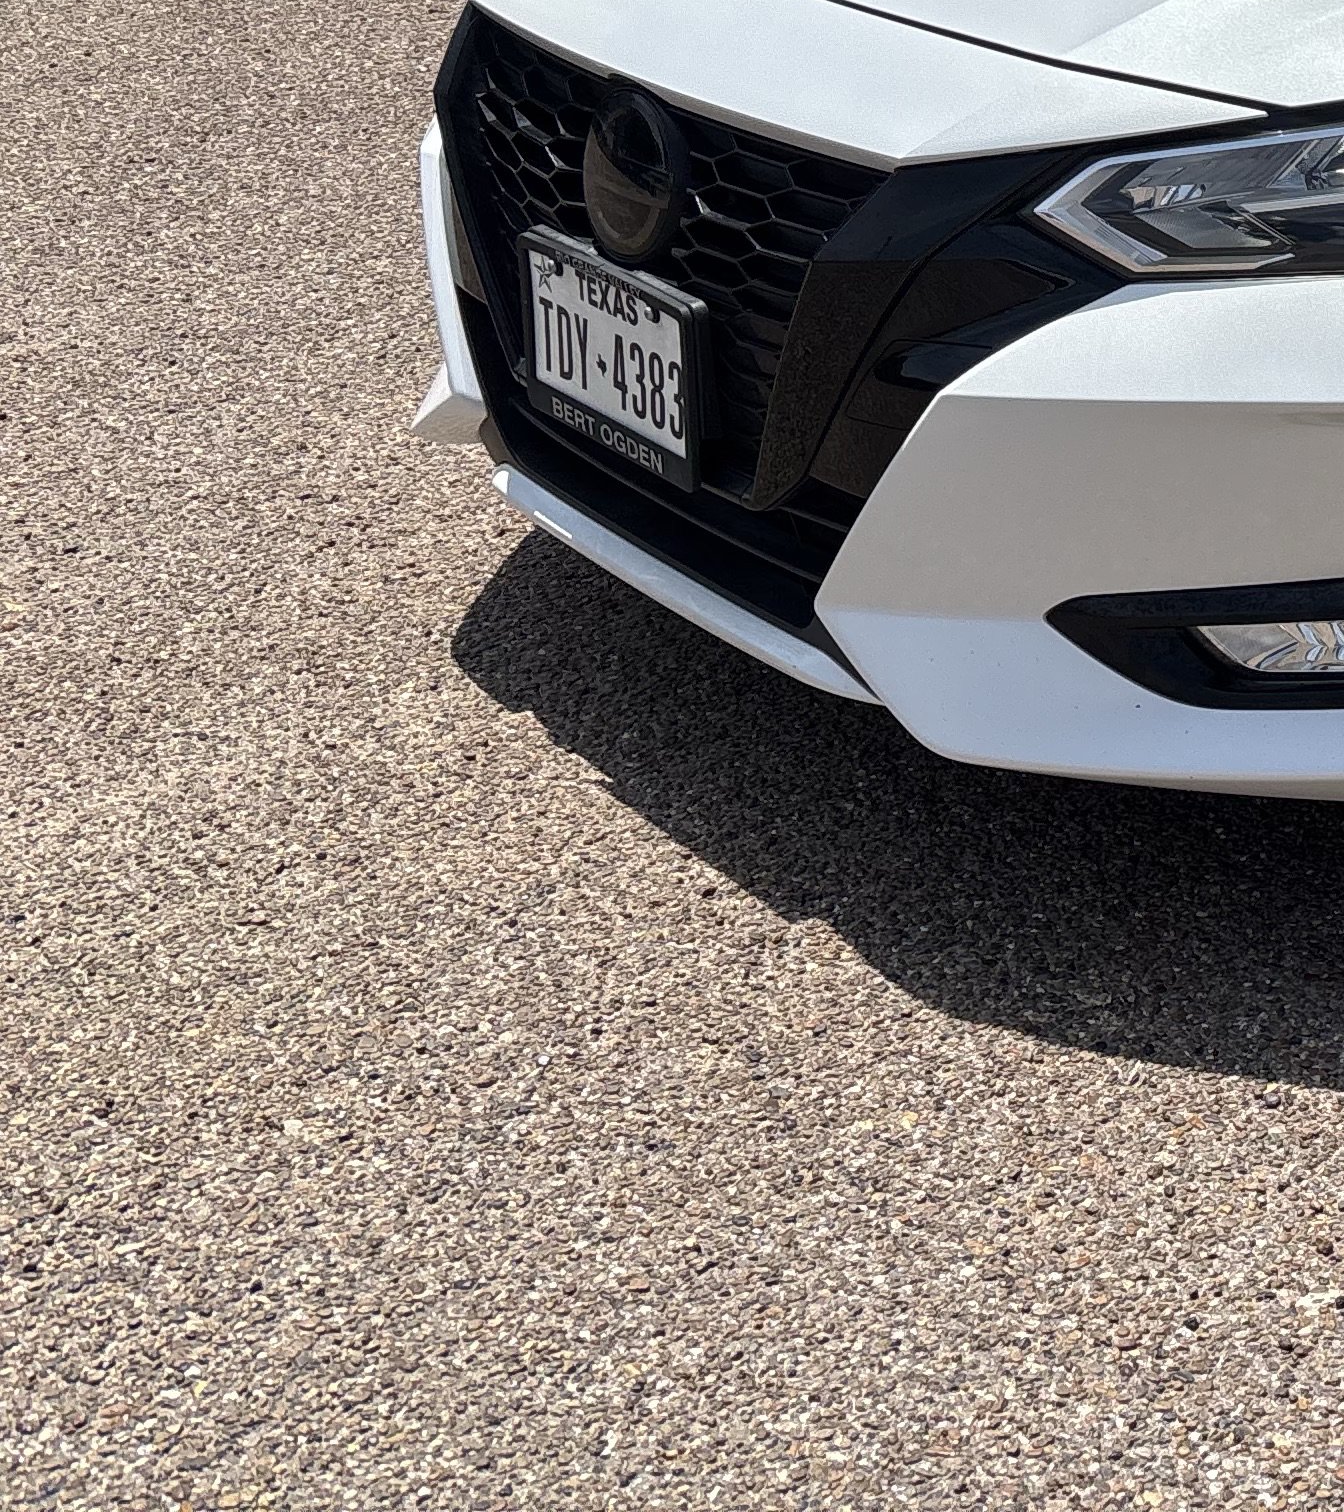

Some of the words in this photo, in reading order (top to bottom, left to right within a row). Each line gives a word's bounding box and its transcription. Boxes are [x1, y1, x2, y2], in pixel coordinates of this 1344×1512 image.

[574, 268, 639, 327] TEXAS
[539, 295, 588, 390] TDY
[613, 333, 684, 440] 4383
[551, 396, 596, 436] BERT
[600, 423, 664, 475] OGDEN
